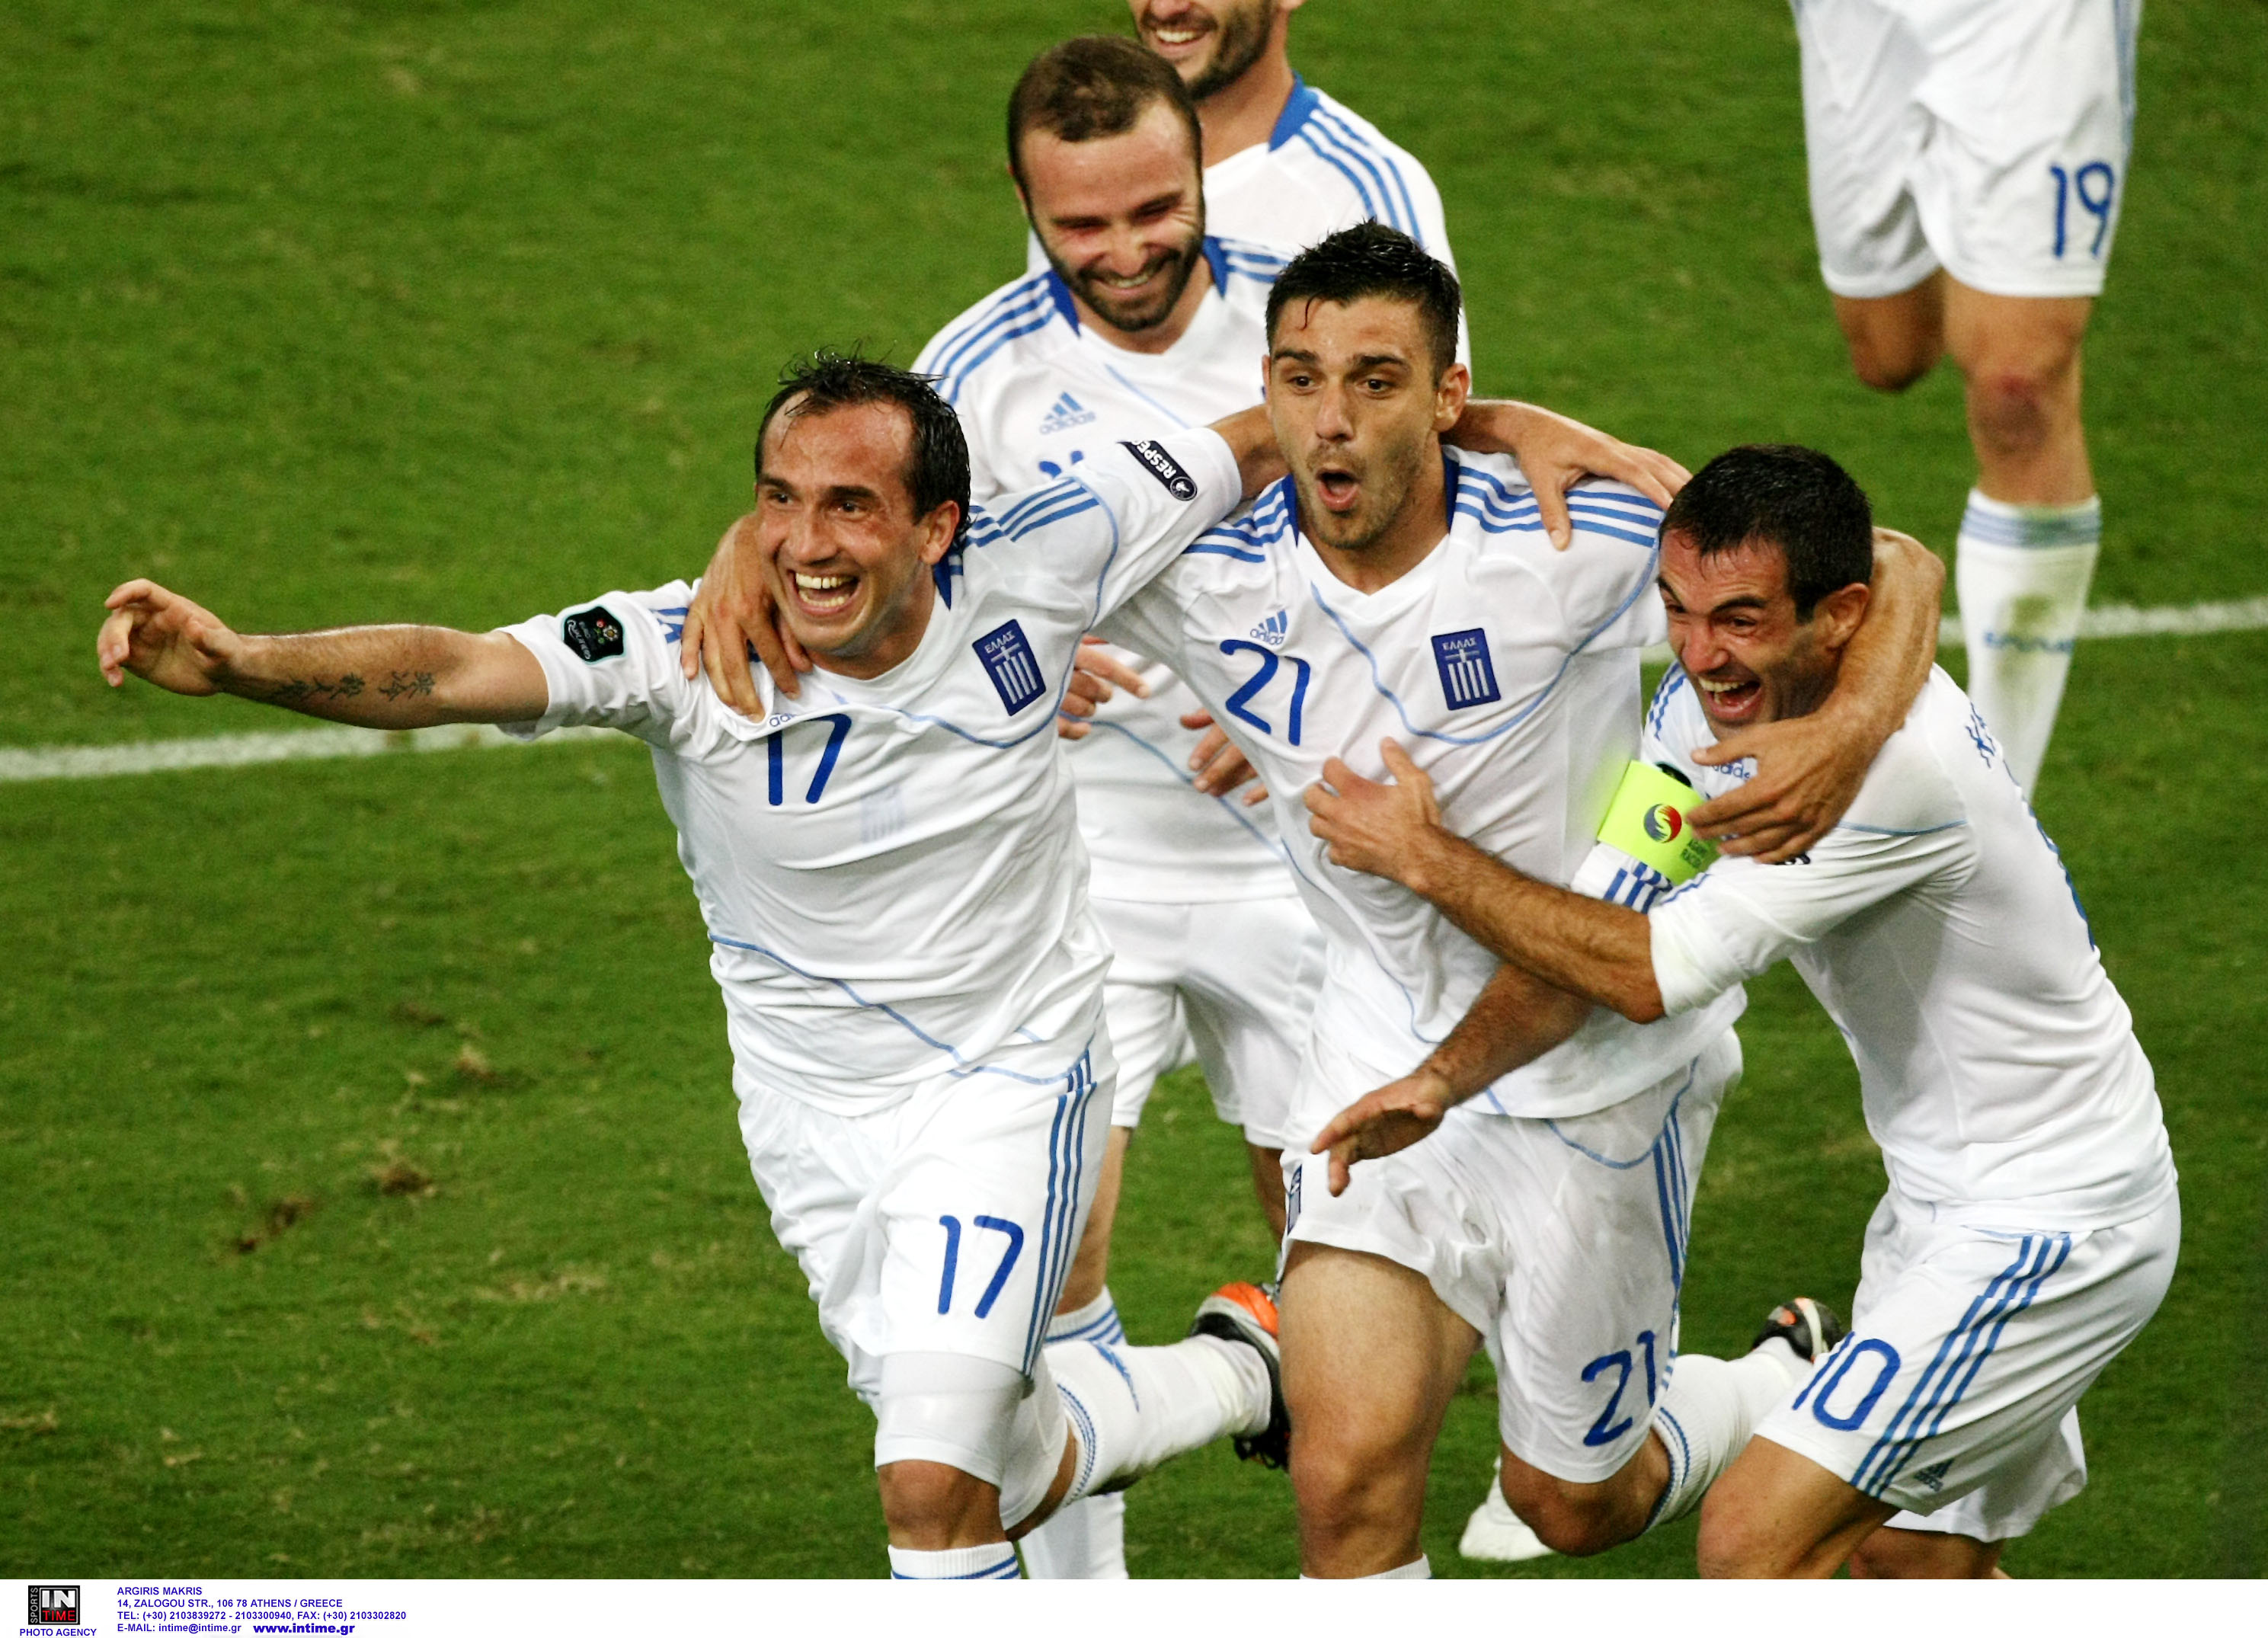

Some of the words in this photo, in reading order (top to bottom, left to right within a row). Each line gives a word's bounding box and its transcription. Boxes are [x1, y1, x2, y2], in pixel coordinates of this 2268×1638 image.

[2049, 162, 2115, 258] 19
[1220, 639, 1310, 747] 21
[768, 713, 852, 806] 17
[937, 1214, 1024, 1319] 17
[1581, 1329, 1655, 1446] 21
[1792, 1331, 1902, 1432] 10
